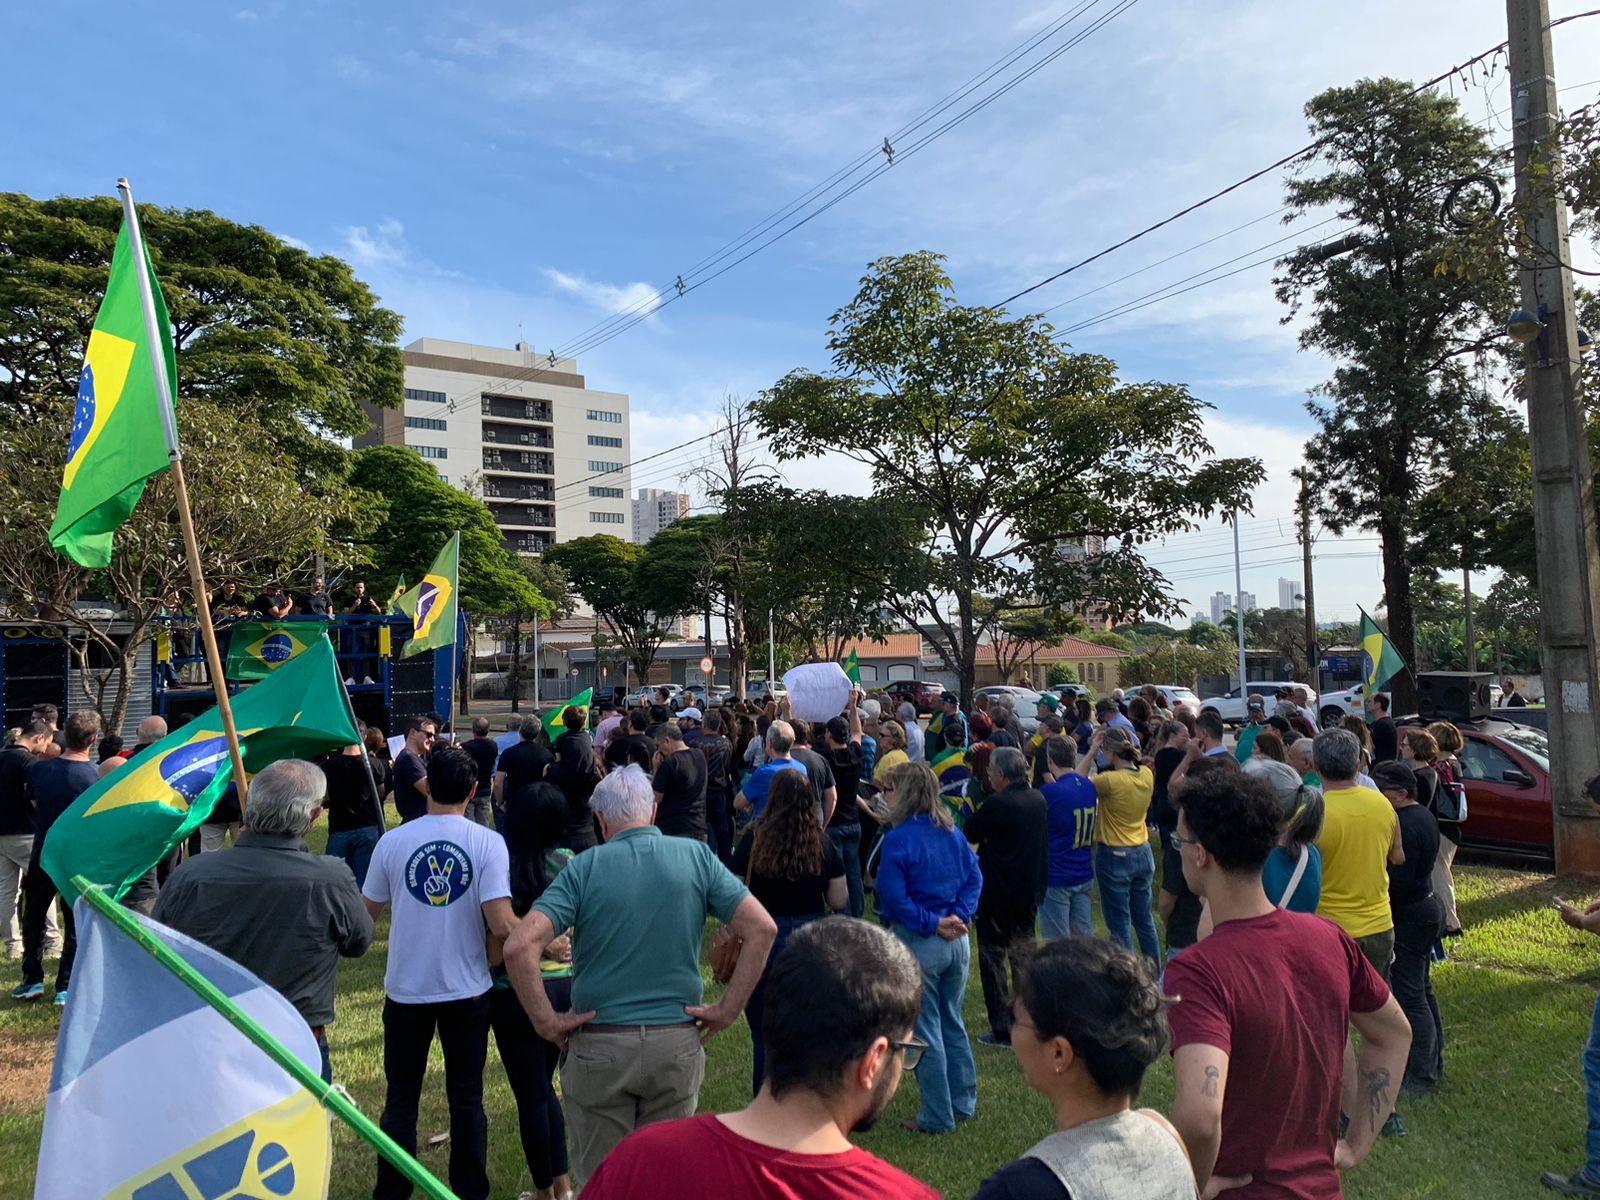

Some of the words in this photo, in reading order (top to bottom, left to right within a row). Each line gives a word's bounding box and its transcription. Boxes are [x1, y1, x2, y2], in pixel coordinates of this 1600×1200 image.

[409, 852, 424, 887] DEMOCRACIA
[424, 844, 436, 854] SIM
[443, 844, 468, 871] COMUNISMO
